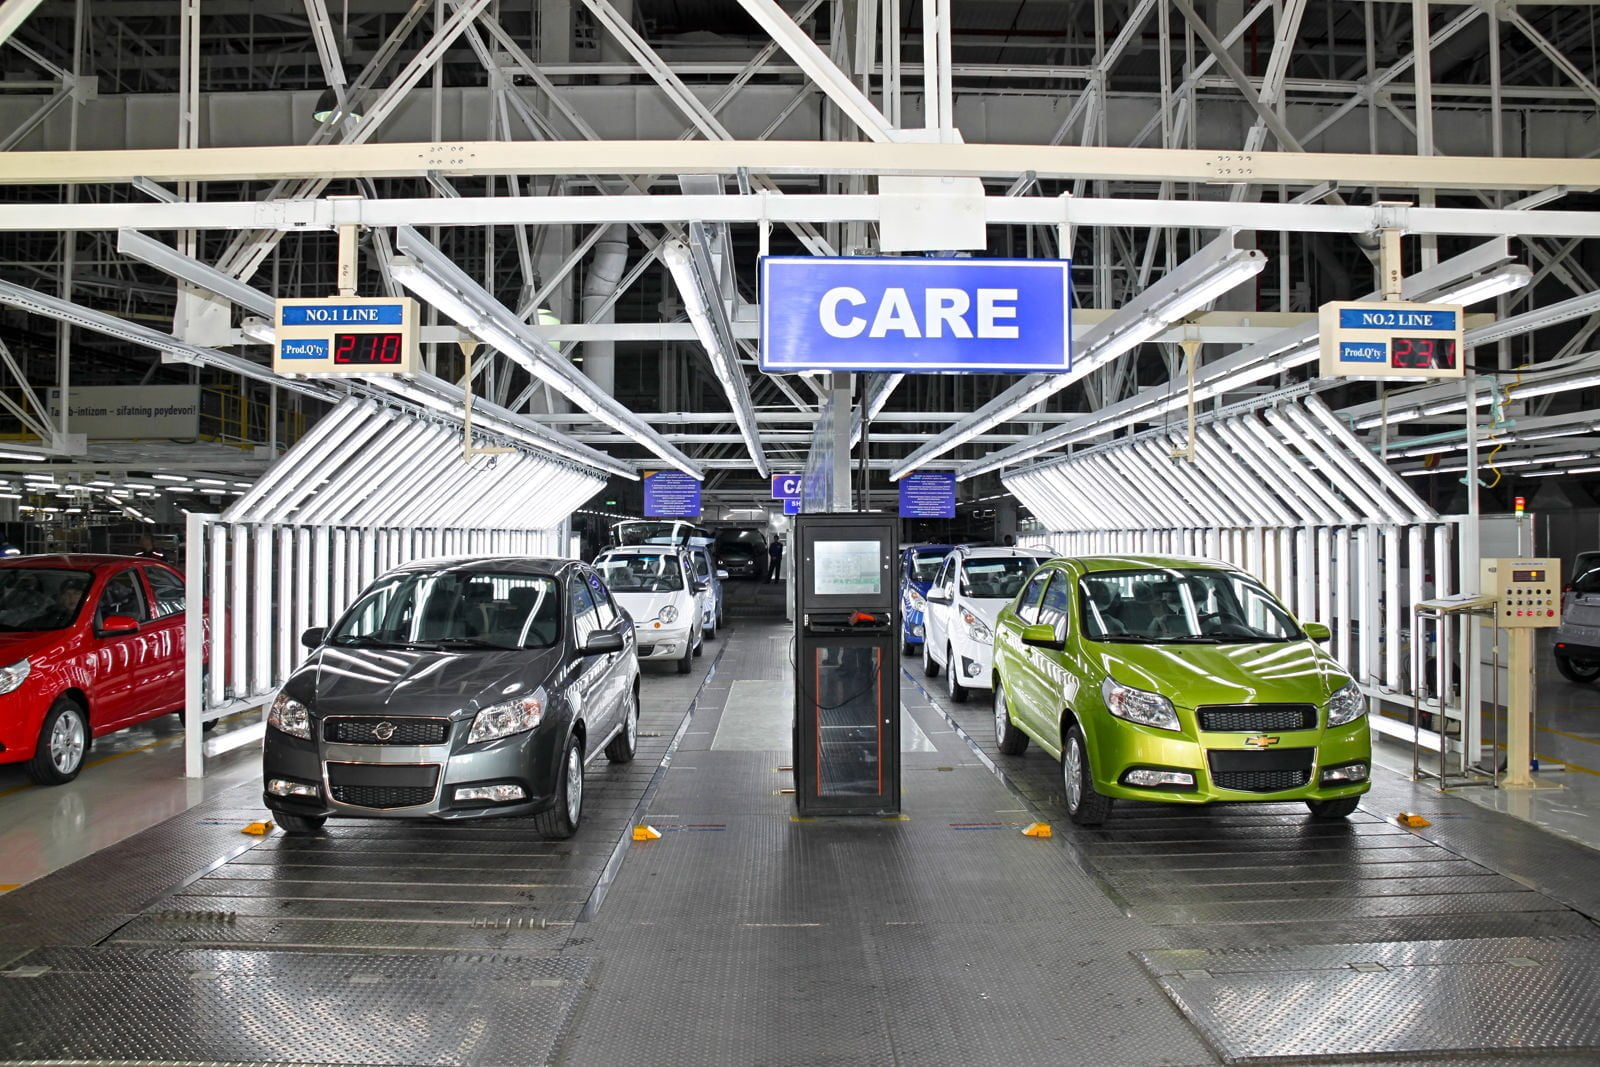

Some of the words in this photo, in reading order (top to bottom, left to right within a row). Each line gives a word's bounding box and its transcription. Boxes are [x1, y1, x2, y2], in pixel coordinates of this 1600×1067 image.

[306, 309, 338, 321] NO.1
[342, 308, 379, 321] LINE
[818, 286, 1020, 339] CARE
[1362, 313, 1395, 326] NO.2
[1398, 314, 1434, 326] LINE
[286, 344, 324, 356] Prod.Q'ty
[335, 335, 401, 363] 210
[1344, 347, 1382, 360] Prod.Q'ty
[1393, 339, 1456, 367] 231
[116, 404, 152, 418] sifatning
